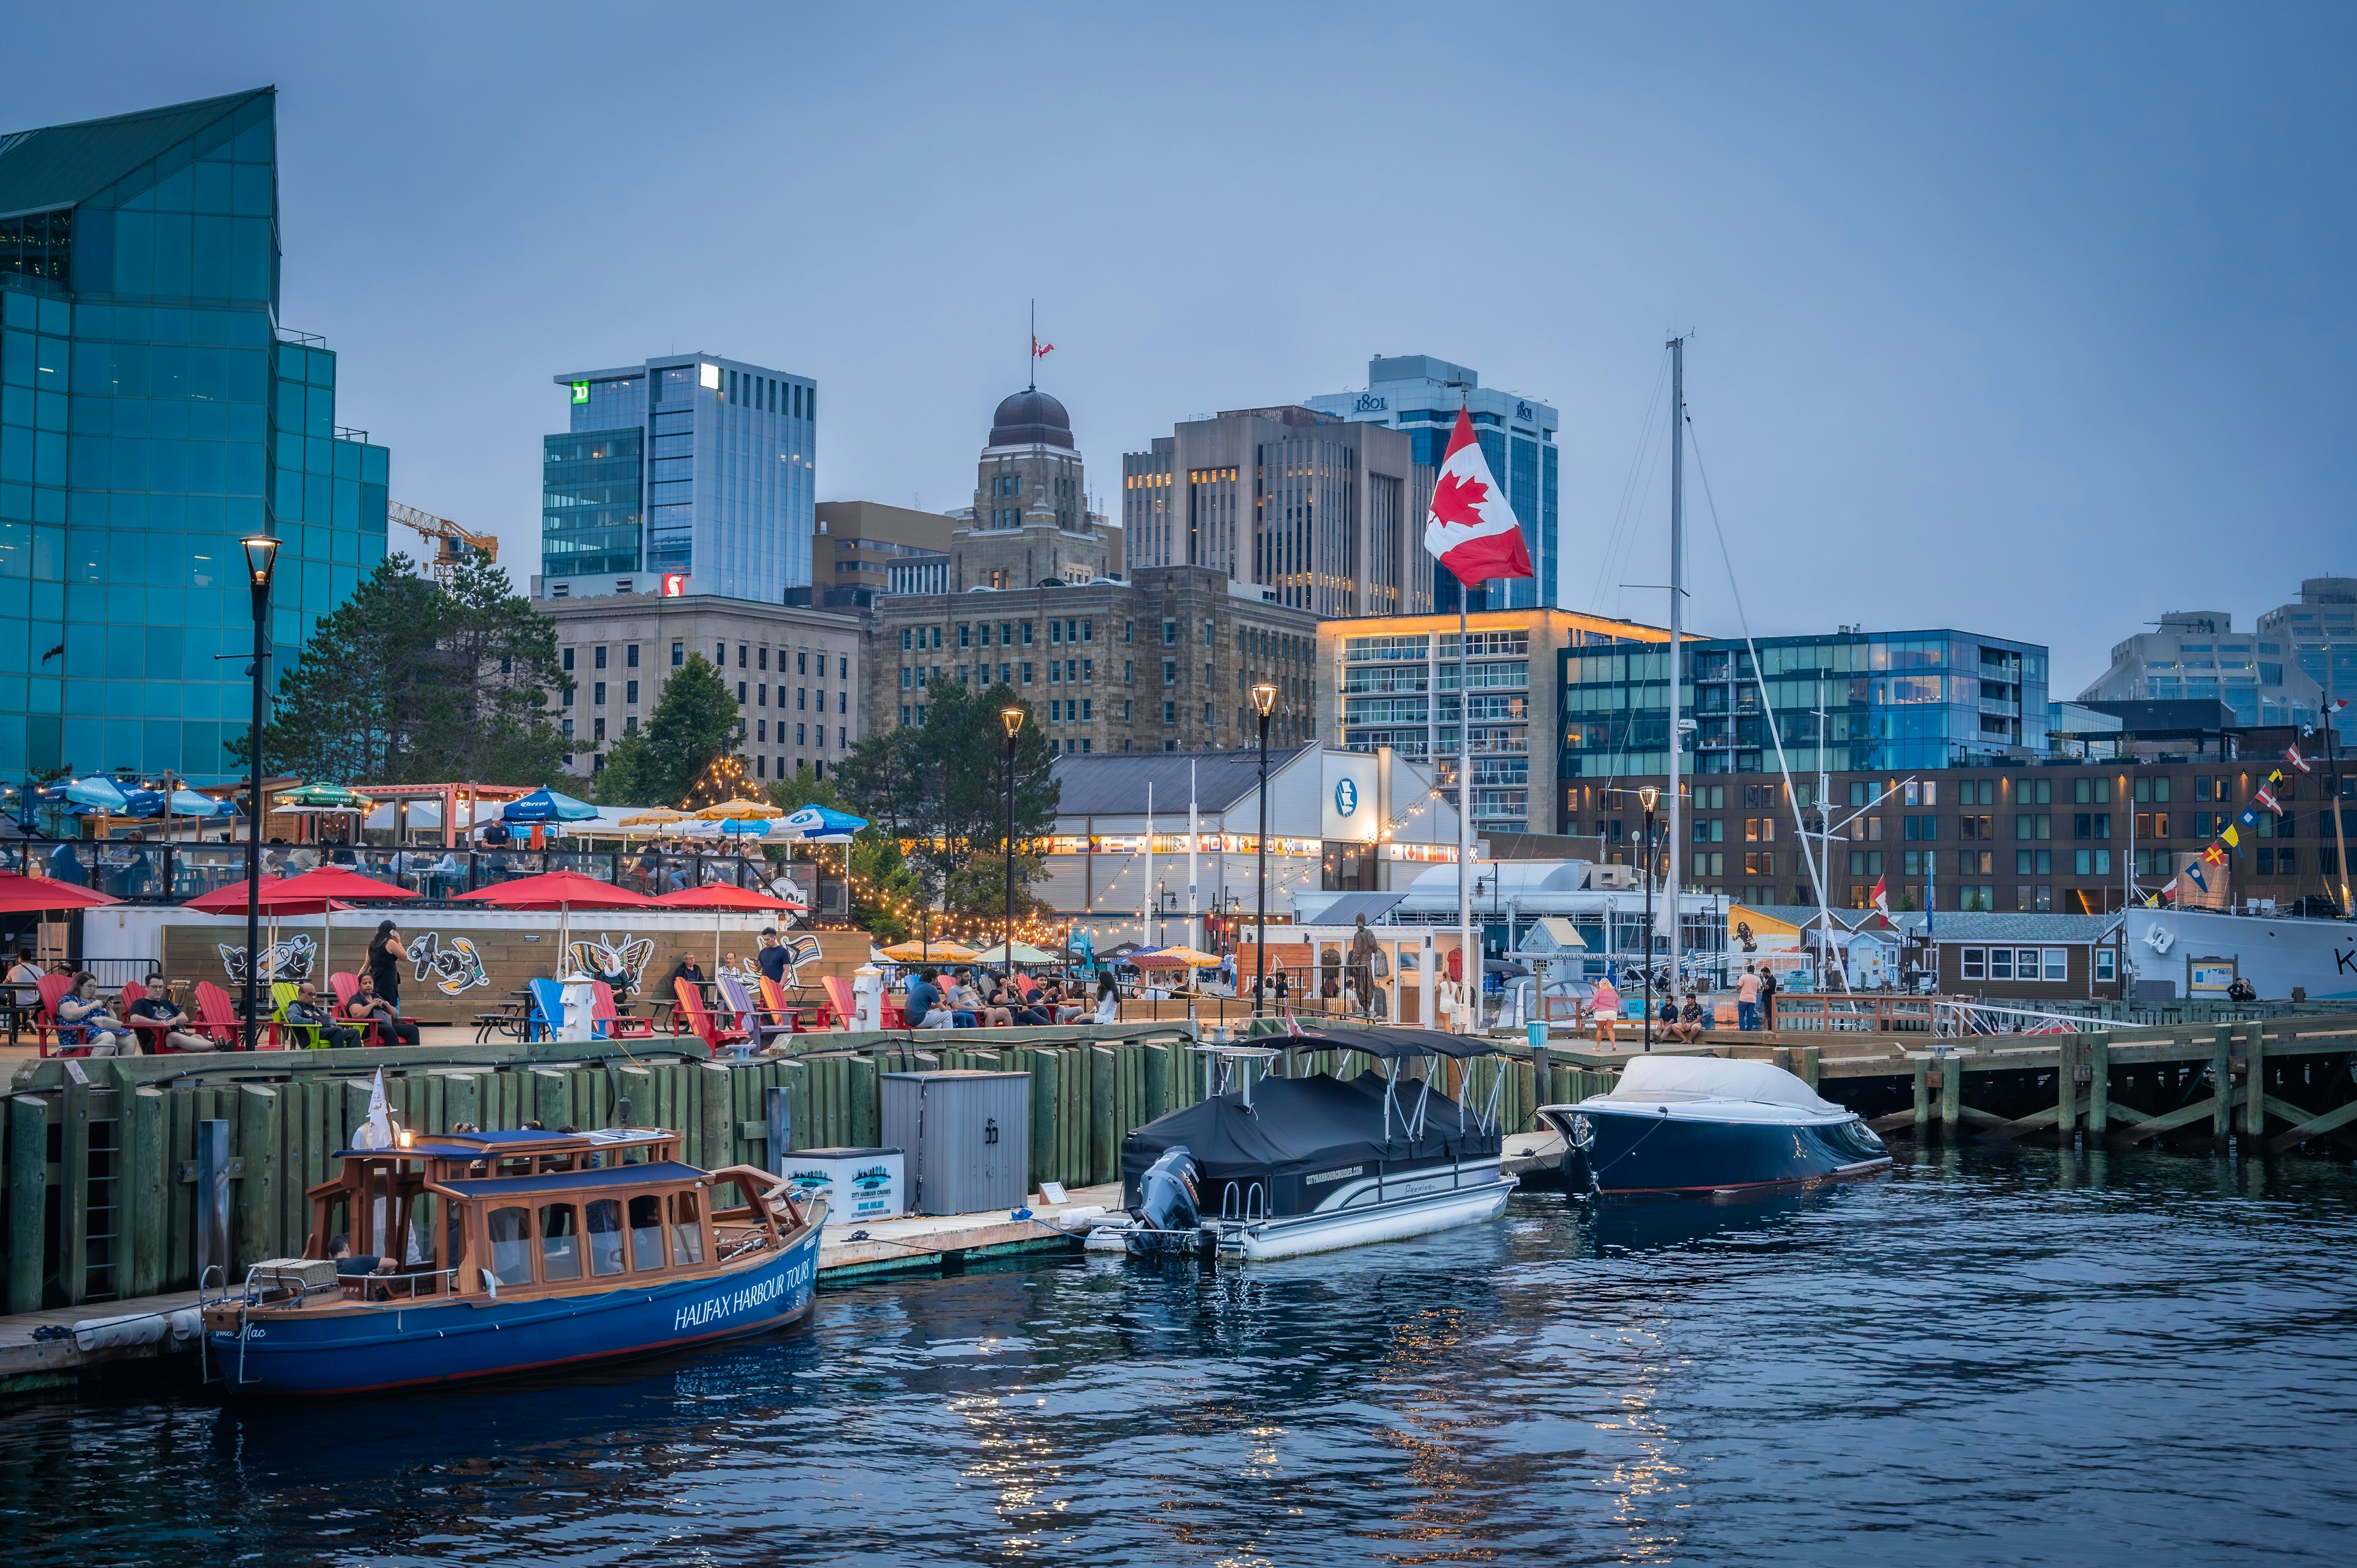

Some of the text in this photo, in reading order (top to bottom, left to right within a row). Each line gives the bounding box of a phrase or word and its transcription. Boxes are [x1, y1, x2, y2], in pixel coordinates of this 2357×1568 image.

[573, 386, 587, 399] TD
[1356, 393, 1385, 410] 1801
[1517, 401, 1532, 419] 1801
[1190, 1167, 1199, 1183] YAMAHA
[1306, 1166, 1363, 1185] CITYHARBOURCRUISES.COM
[851, 1209, 891, 1218] CITYHARBOURCRUISES.COM
[675, 1258, 810, 1330] HALIFAX HARBOUR TOURS
[236, 1323, 266, 1341] Mac
